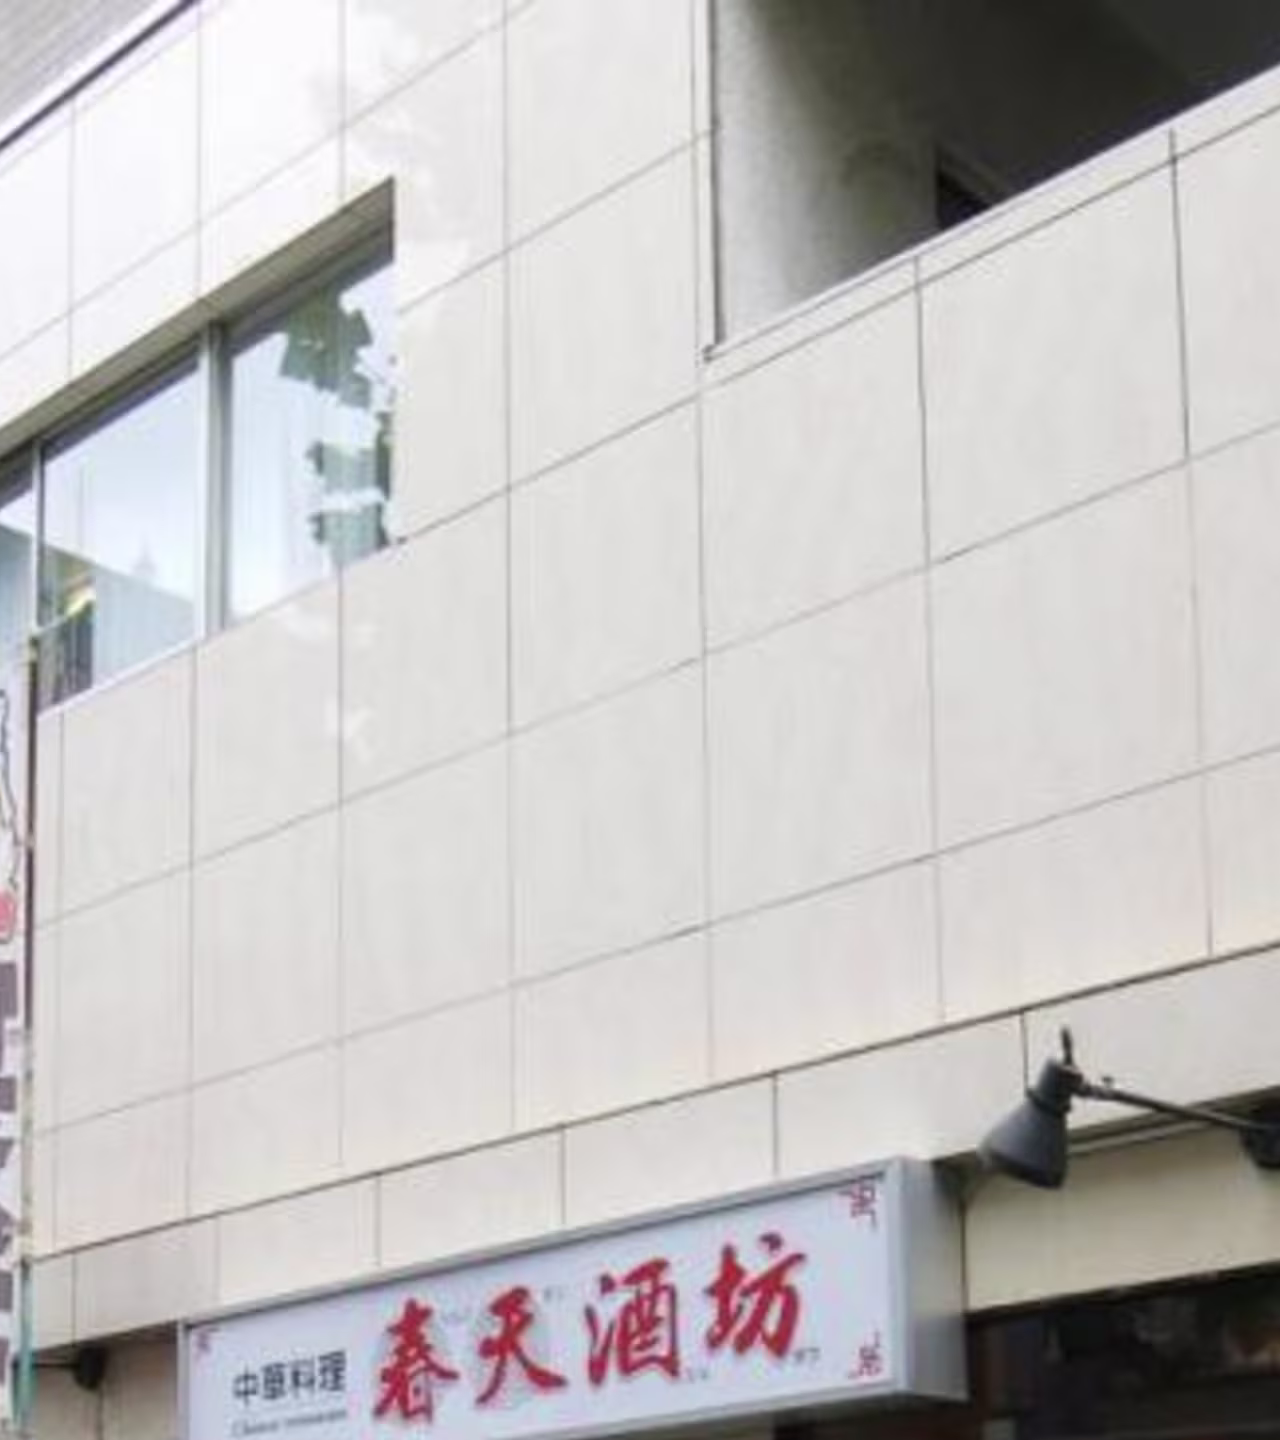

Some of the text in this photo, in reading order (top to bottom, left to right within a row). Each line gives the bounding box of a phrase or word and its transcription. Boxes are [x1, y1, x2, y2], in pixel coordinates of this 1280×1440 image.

[232, 1348, 347, 1406] 中華料理
[372, 1232, 806, 1424] 春天酒坊
